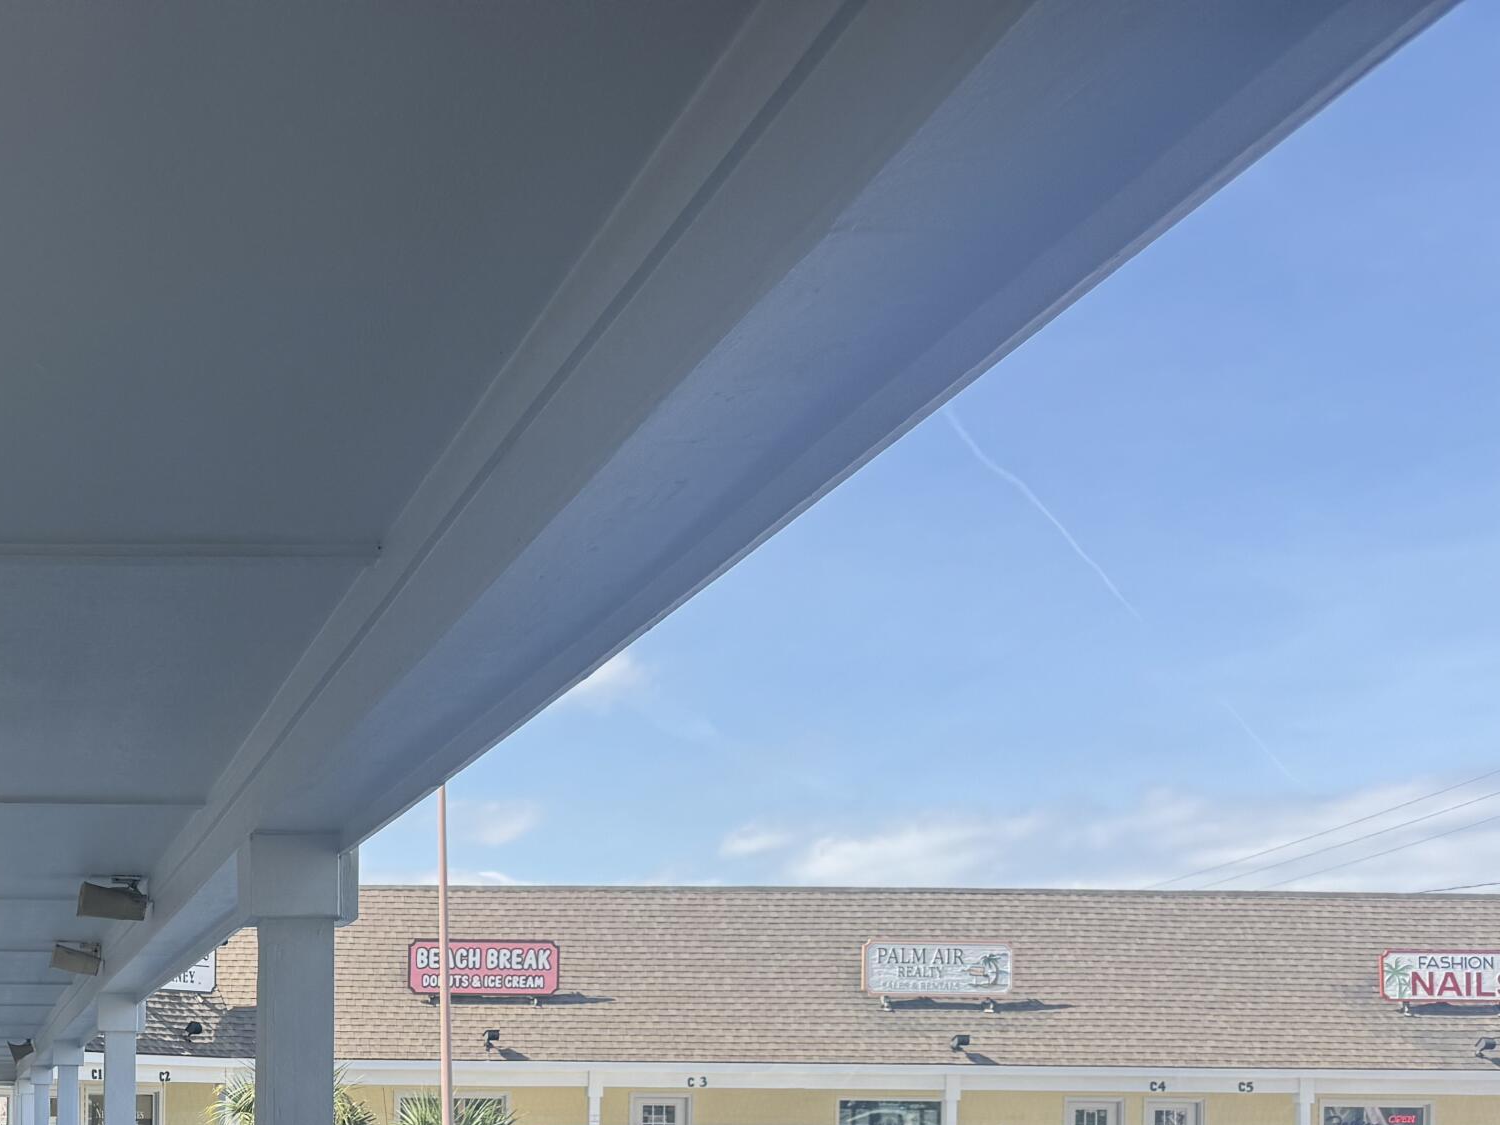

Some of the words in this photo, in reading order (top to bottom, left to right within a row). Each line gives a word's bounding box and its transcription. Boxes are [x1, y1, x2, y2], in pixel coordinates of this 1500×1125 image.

[486, 948, 552, 970] BREAK
[876, 947, 926, 964] PALM
[933, 948, 964, 965] AIR
[1418, 956, 1494, 969] FASHION
[897, 966, 944, 978] REALTY
[471, 974, 482, 987] &
[484, 975, 502, 988] ICE
[503, 975, 544, 988] CREAM
[1411, 971, 1500, 997] NAIL
[91, 1069, 103, 1080] C1
[159, 1071, 171, 1082] C2
[1149, 1081, 1166, 1092] C4
[1238, 1081, 1254, 1092] C5
[1388, 1115, 1415, 1124] OPEN
